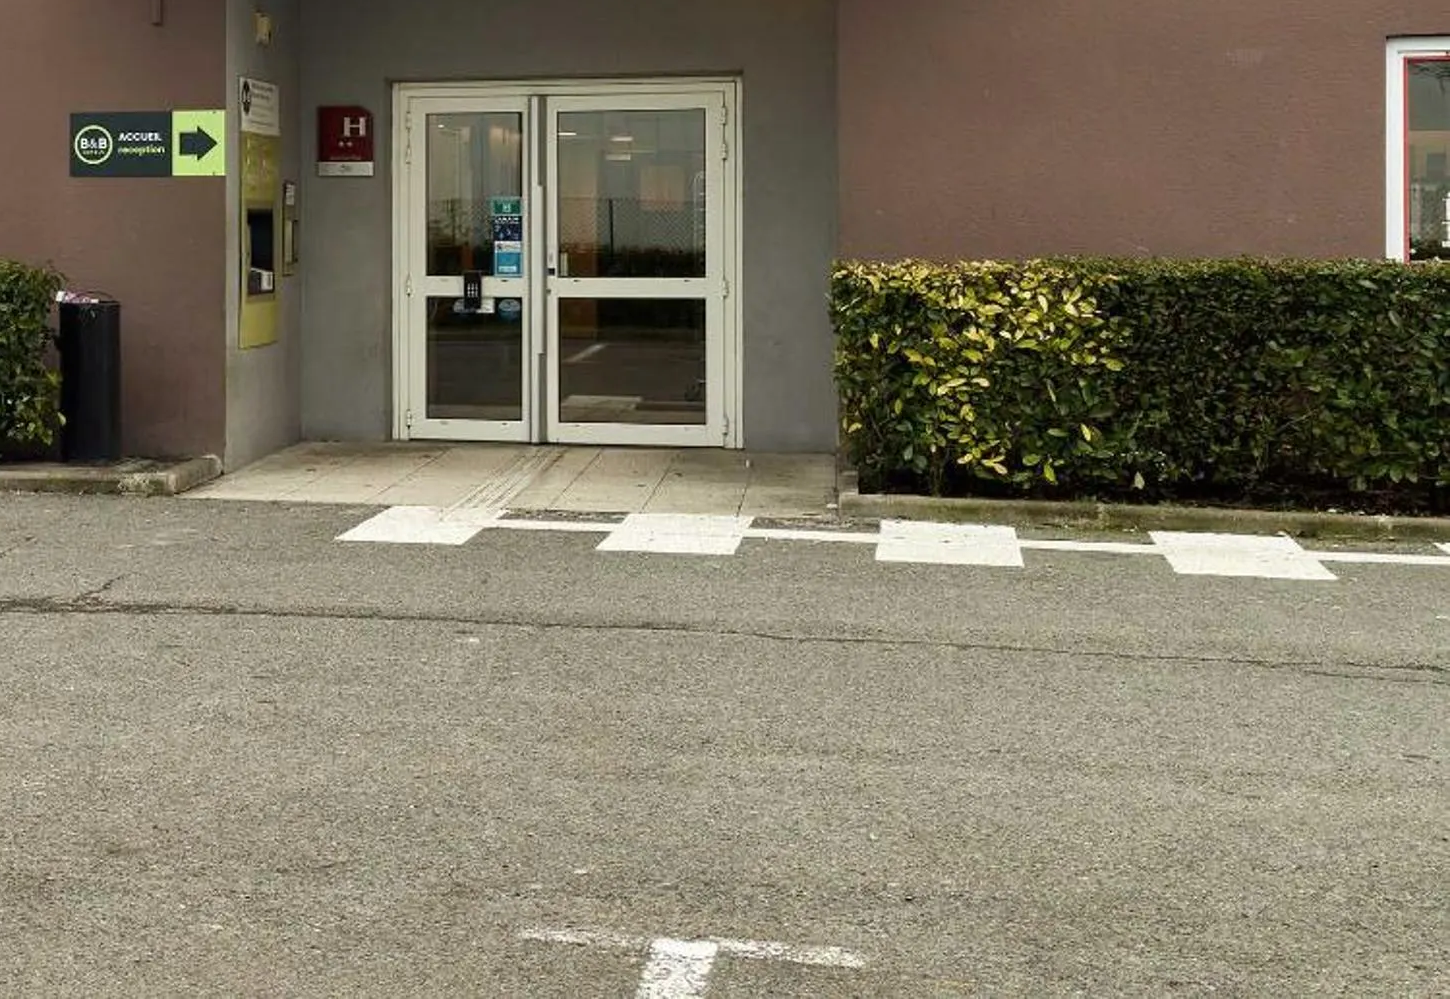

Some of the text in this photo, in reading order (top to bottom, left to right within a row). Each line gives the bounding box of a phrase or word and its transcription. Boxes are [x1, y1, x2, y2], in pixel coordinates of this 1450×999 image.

[343, 116, 366, 137] H
[80, 137, 108, 150] B&B
[118, 132, 162, 142] ACCUEIL
